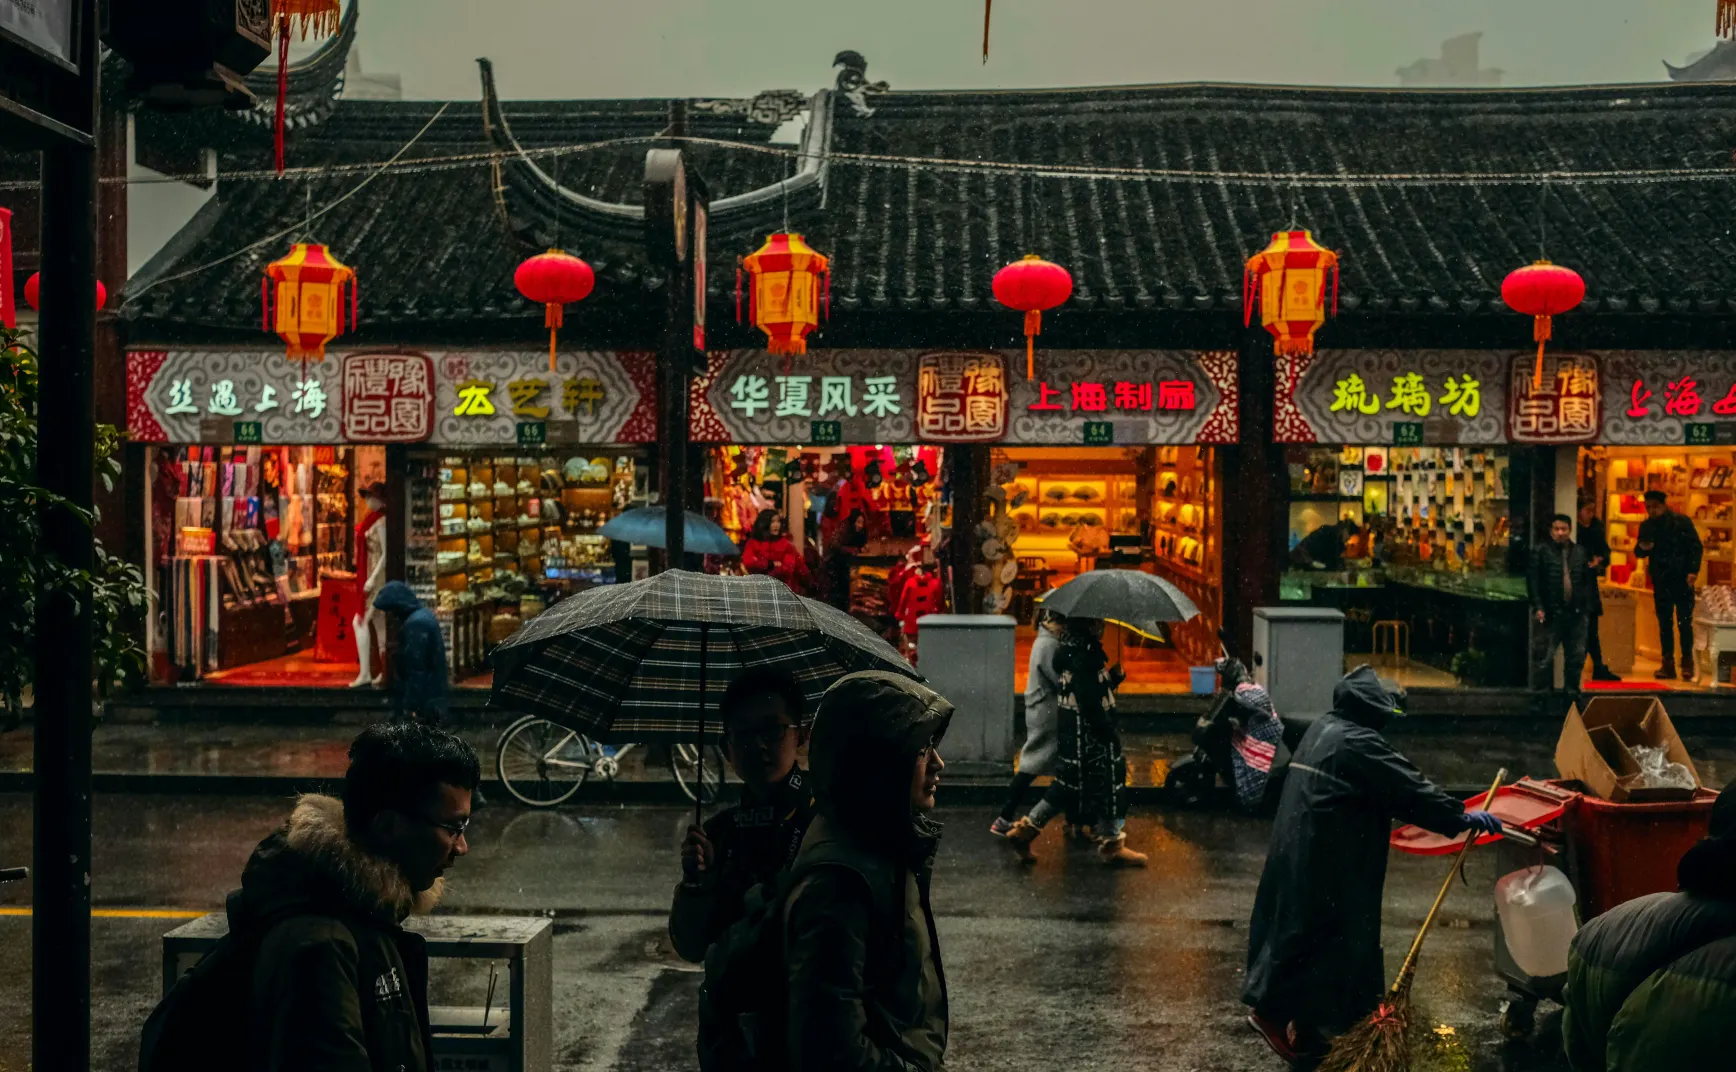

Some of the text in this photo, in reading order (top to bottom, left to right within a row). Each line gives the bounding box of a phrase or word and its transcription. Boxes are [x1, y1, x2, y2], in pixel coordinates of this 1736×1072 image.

[454, 377, 604, 418] 宏艺轩
[731, 375, 900, 417] 华夏风采
[1028, 379, 1195, 412] 上海制扇
[1330, 373, 1480, 417] 琉璃坊
[524, 424, 538, 437] 66
[819, 423, 834, 435] 64
[1400, 424, 1416, 437] 62
[1692, 425, 1708, 438] 62
